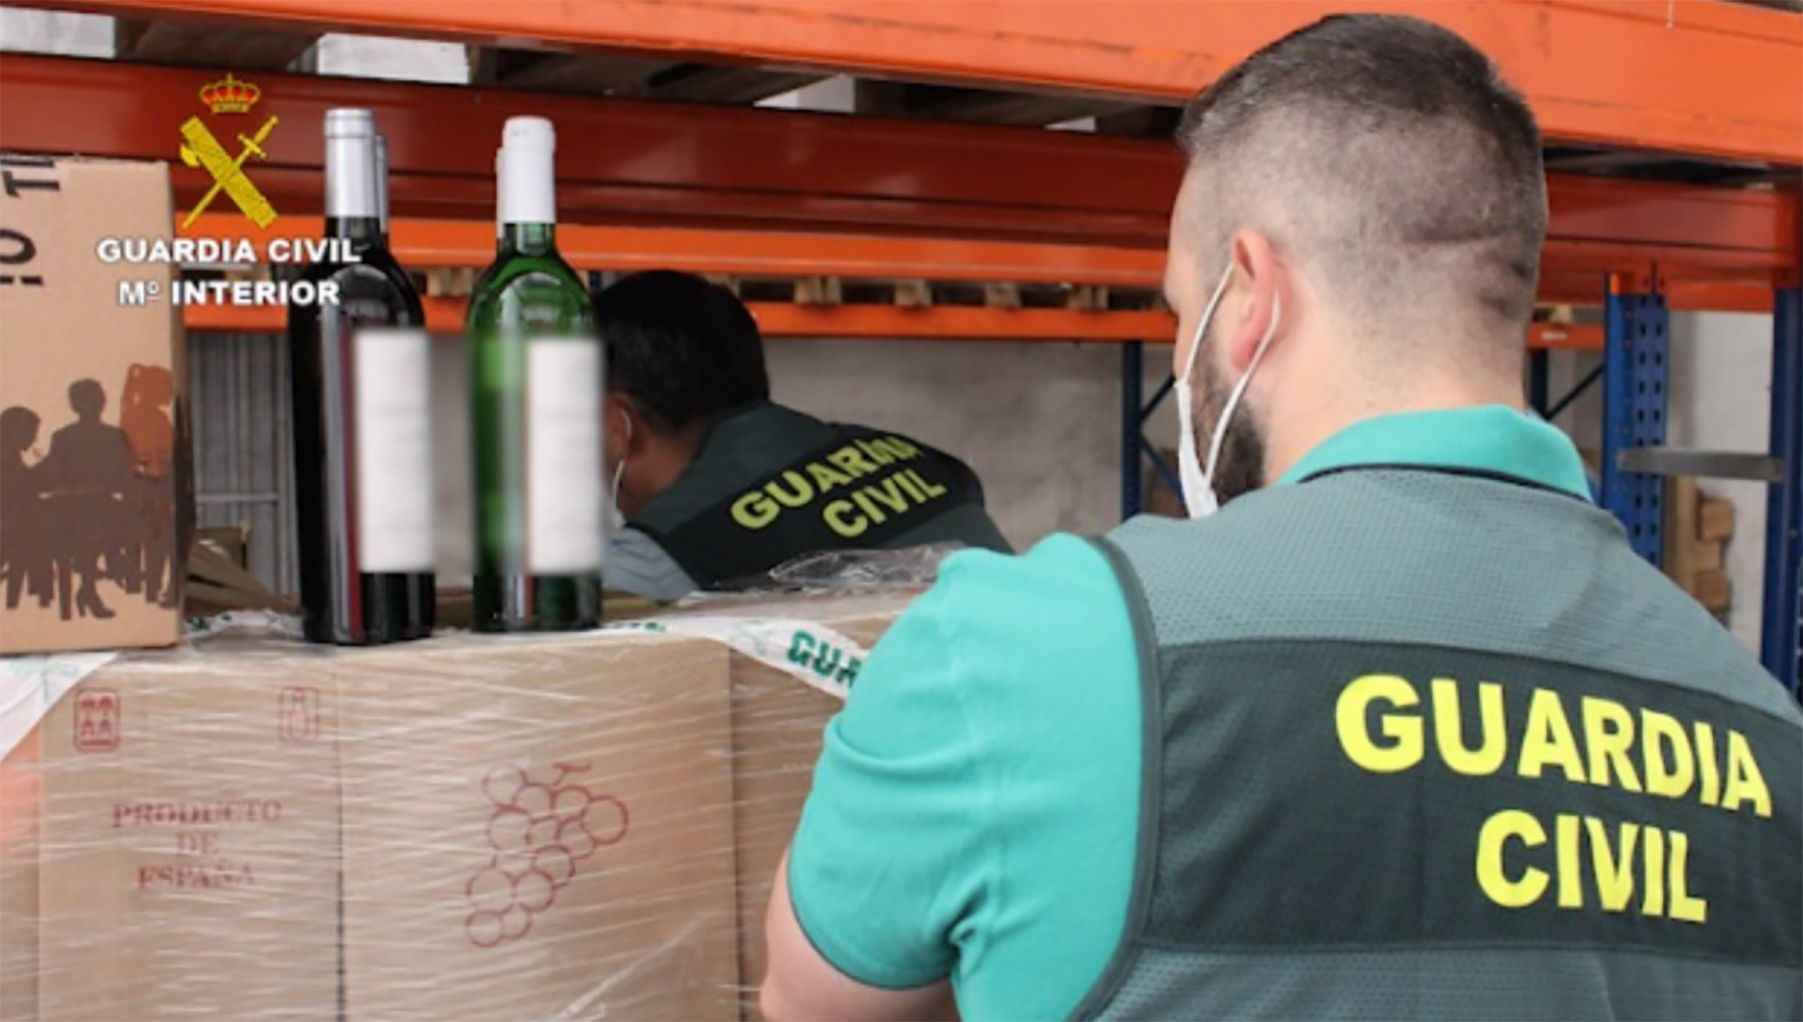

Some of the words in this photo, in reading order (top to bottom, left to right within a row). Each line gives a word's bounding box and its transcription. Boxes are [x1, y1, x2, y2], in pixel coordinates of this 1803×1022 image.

[822, 468, 948, 538] CIVIL
[1335, 674, 1773, 818] GUARDIA
[175, 831, 221, 857] DE
[1476, 810, 1708, 923] CIVIL
